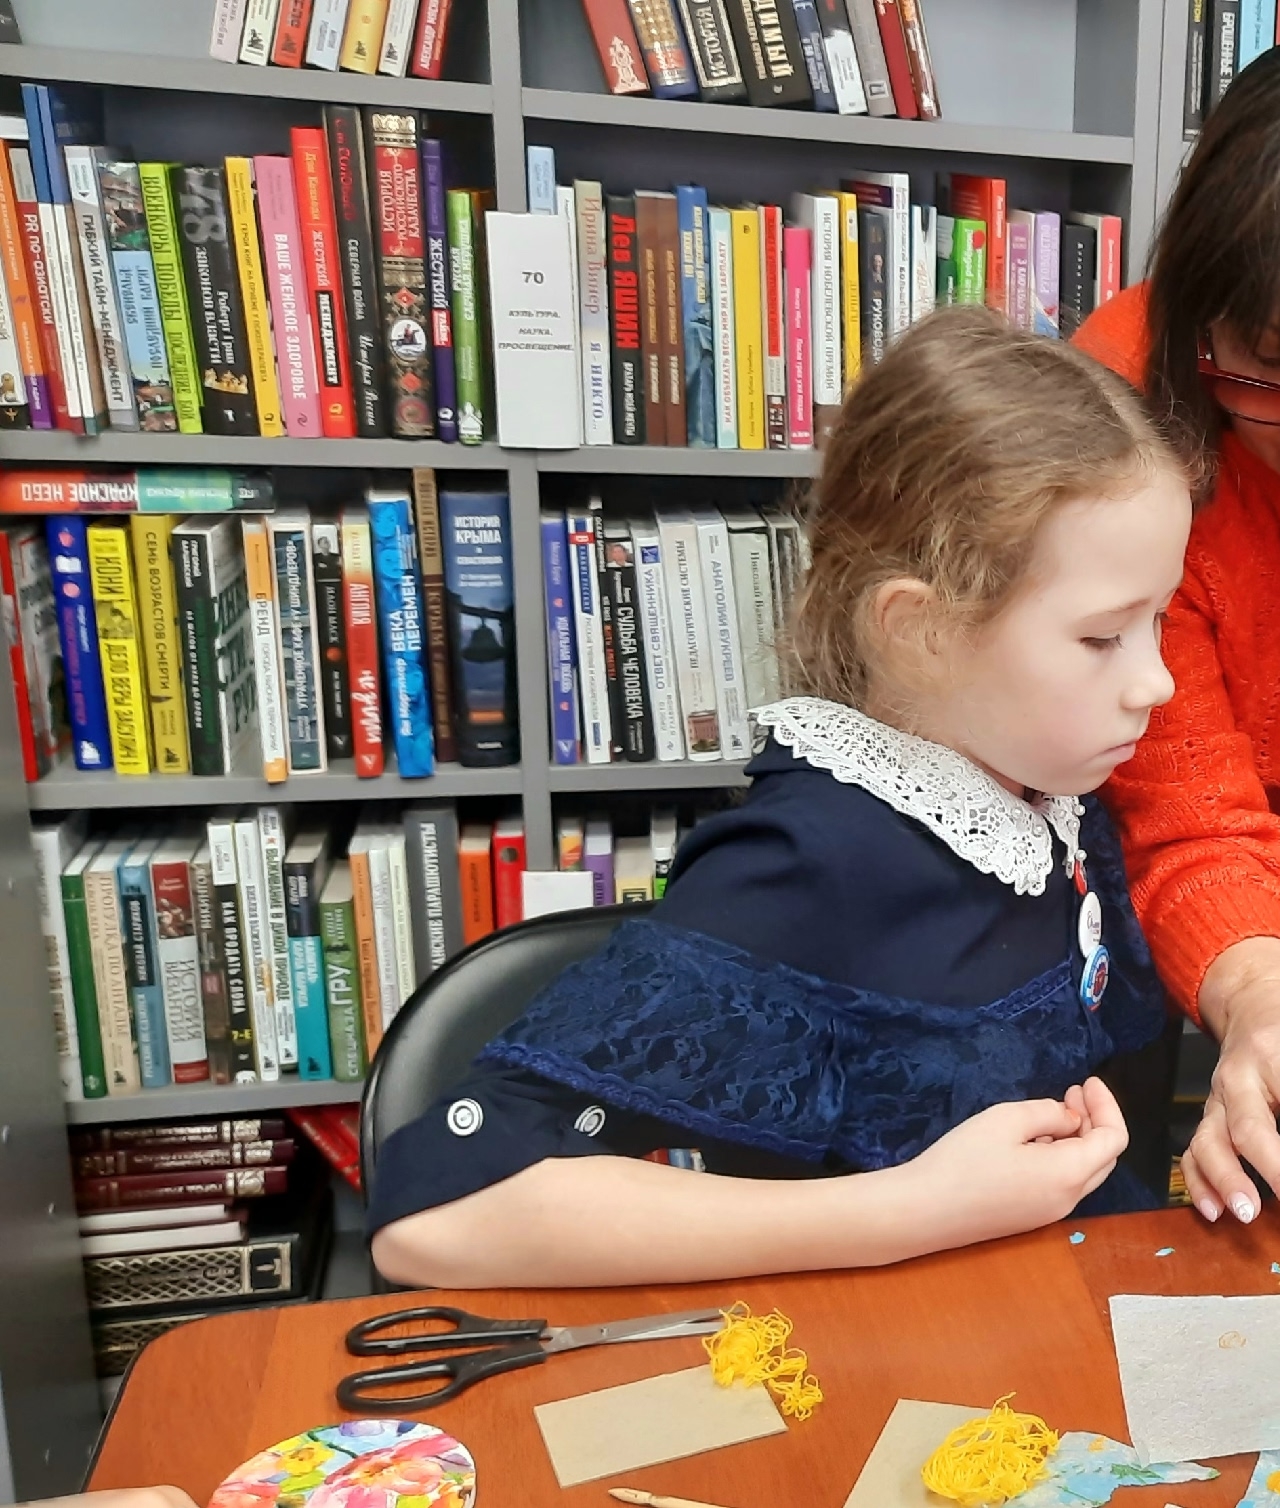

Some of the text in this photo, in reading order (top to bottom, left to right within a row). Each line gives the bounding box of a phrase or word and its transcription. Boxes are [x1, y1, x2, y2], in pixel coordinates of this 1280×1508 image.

[700, 5, 729, 78] ИСТОРИЯ
[180, 172, 227, 244] 48
[381, 170, 396, 232] ИСТОРИЯ
[395, 164, 406, 242] РОССИЙСКОГО
[407, 168, 421, 238] КАЗАЧЕСТВА
[582, 196, 600, 256] Ирина
[24, 213, 55, 326] PR по-азиатски
[142, 175, 171, 256] ВОЕНКОРЫ
[157, 263, 182, 321] ПОБЕДЫ
[171, 331, 191, 394] ПОСЛЕДНИЕ
[312, 230, 330, 287] ЖЕСТКИЙ
[348, 239, 362, 287] СЕВЕРНАЯ
[429, 237, 448, 310] ЖЕСТКИЙ
[522, 271, 544, 284] 70
[584, 258, 602, 315] Винер
[611, 213, 640, 349] Лев ЯШИН
[718, 241, 729, 288] ЗАРПЛАТУ
[82, 213, 125, 403] ГИБКИЙ ТАЙМ-МЕНЕДЖМЕНТ
[216, 290, 233, 333] Роберт
[275, 233, 306, 400] ВАШЕ ЖЕНСКОЕ ЗДОРОВЬЕ
[353, 289, 366, 321] ВОЙНА
[720, 311, 730, 331] МИР
[823, 212, 836, 390] ИСТОРИЯ НОБЕЛЕВСКОЙ ПРЕМИИ
[319, 294, 339, 385] МЕНЕДЖМЕНТ
[721, 333, 731, 357] ВЕСЬ
[722, 358, 732, 403] ОБЪЕХАТЬ
[724, 405, 733, 423] КАК
[22, 482, 64, 502] НЕБО
[70, 482, 139, 502] КРАСНОЕ
[454, 515, 501, 530] ИСТОРИЯ
[455, 529, 502, 546] КРЫМА
[95, 555, 126, 595] КОНИ
[750, 551, 764, 597] Николай
[146, 531, 170, 690] СЕМЬ ВОЗРАСТОВ СМЕРТИ
[255, 592, 271, 637] БРЕНД
[292, 621, 305, 649] КАФЕ
[324, 585, 339, 644] ИЛОН МАСК
[393, 611, 405, 652] ВЕКА
[407, 575, 422, 652] ПЕРЕМЕН
[616, 605, 639, 655] СУДЬБА
[643, 568, 666, 690] ОТВЕТ СВЯЩЕННИКА
[675, 540, 700, 670] ПЕДАГОГИЧЕСКИЕ СИСТЕМЫ
[293, 649, 309, 710] УТРАЧЕННОЕ
[719, 628, 736, 682] БУКРЕЕВ
[106, 642, 139, 760] ДЕЛО ВЕРЫ ЗАСУЛИЧ
[398, 658, 410, 719] Мортимер
[622, 656, 645, 719] ЧЕЛОВЕКА
[246, 884, 259, 919] БИБЛИЯ
[265, 848, 284, 910] ВЫЖИВАНИЕ
[419, 821, 447, 972] АНСКИЕ ПАРАШЮТИСТЫ
[100, 876, 122, 951] ПРОГУЛКА
[130, 900, 147, 982] НИКОЛАЙ СТАРИКОВ
[271, 920, 286, 954] ДИКОЙ
[108, 954, 122, 976] ПО
[221, 901, 246, 1014] КАК ПРОДАТЬ СЛОНА
[273, 956, 291, 1002] ПРИРОДЕ
[328, 963, 352, 1005] ГРУ
[165, 960, 184, 1044] ВИЗАНТИИ
[180, 958, 203, 1041] ИСТОРИЯ
[339, 1006, 359, 1077] СПЕЦНАЗА
